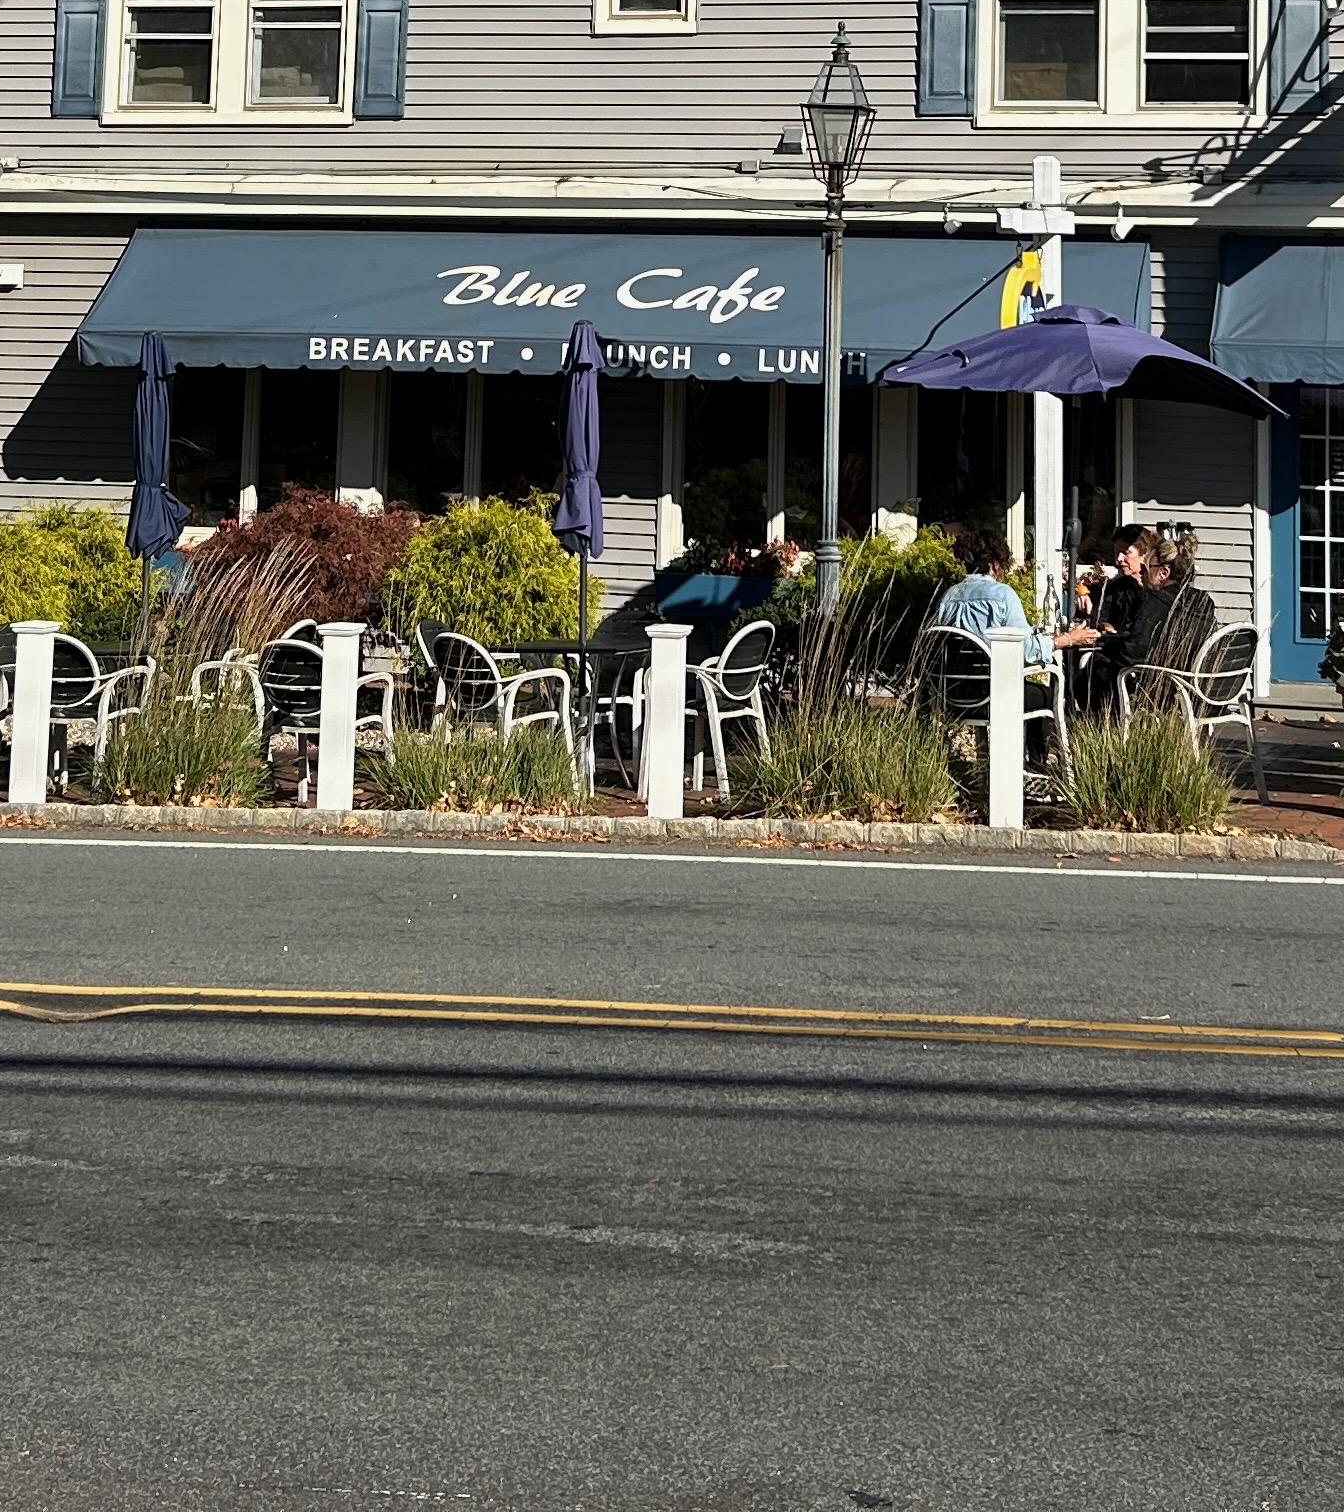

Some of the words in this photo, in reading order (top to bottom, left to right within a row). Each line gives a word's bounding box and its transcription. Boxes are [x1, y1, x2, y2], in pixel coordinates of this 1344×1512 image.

[436, 265, 587, 308] Blue
[615, 267, 786, 325] Cafe
[308, 337, 495, 364] BREAKFAST
[560, 342, 692, 371] UNCH
[758, 348, 866, 376] LUNH
